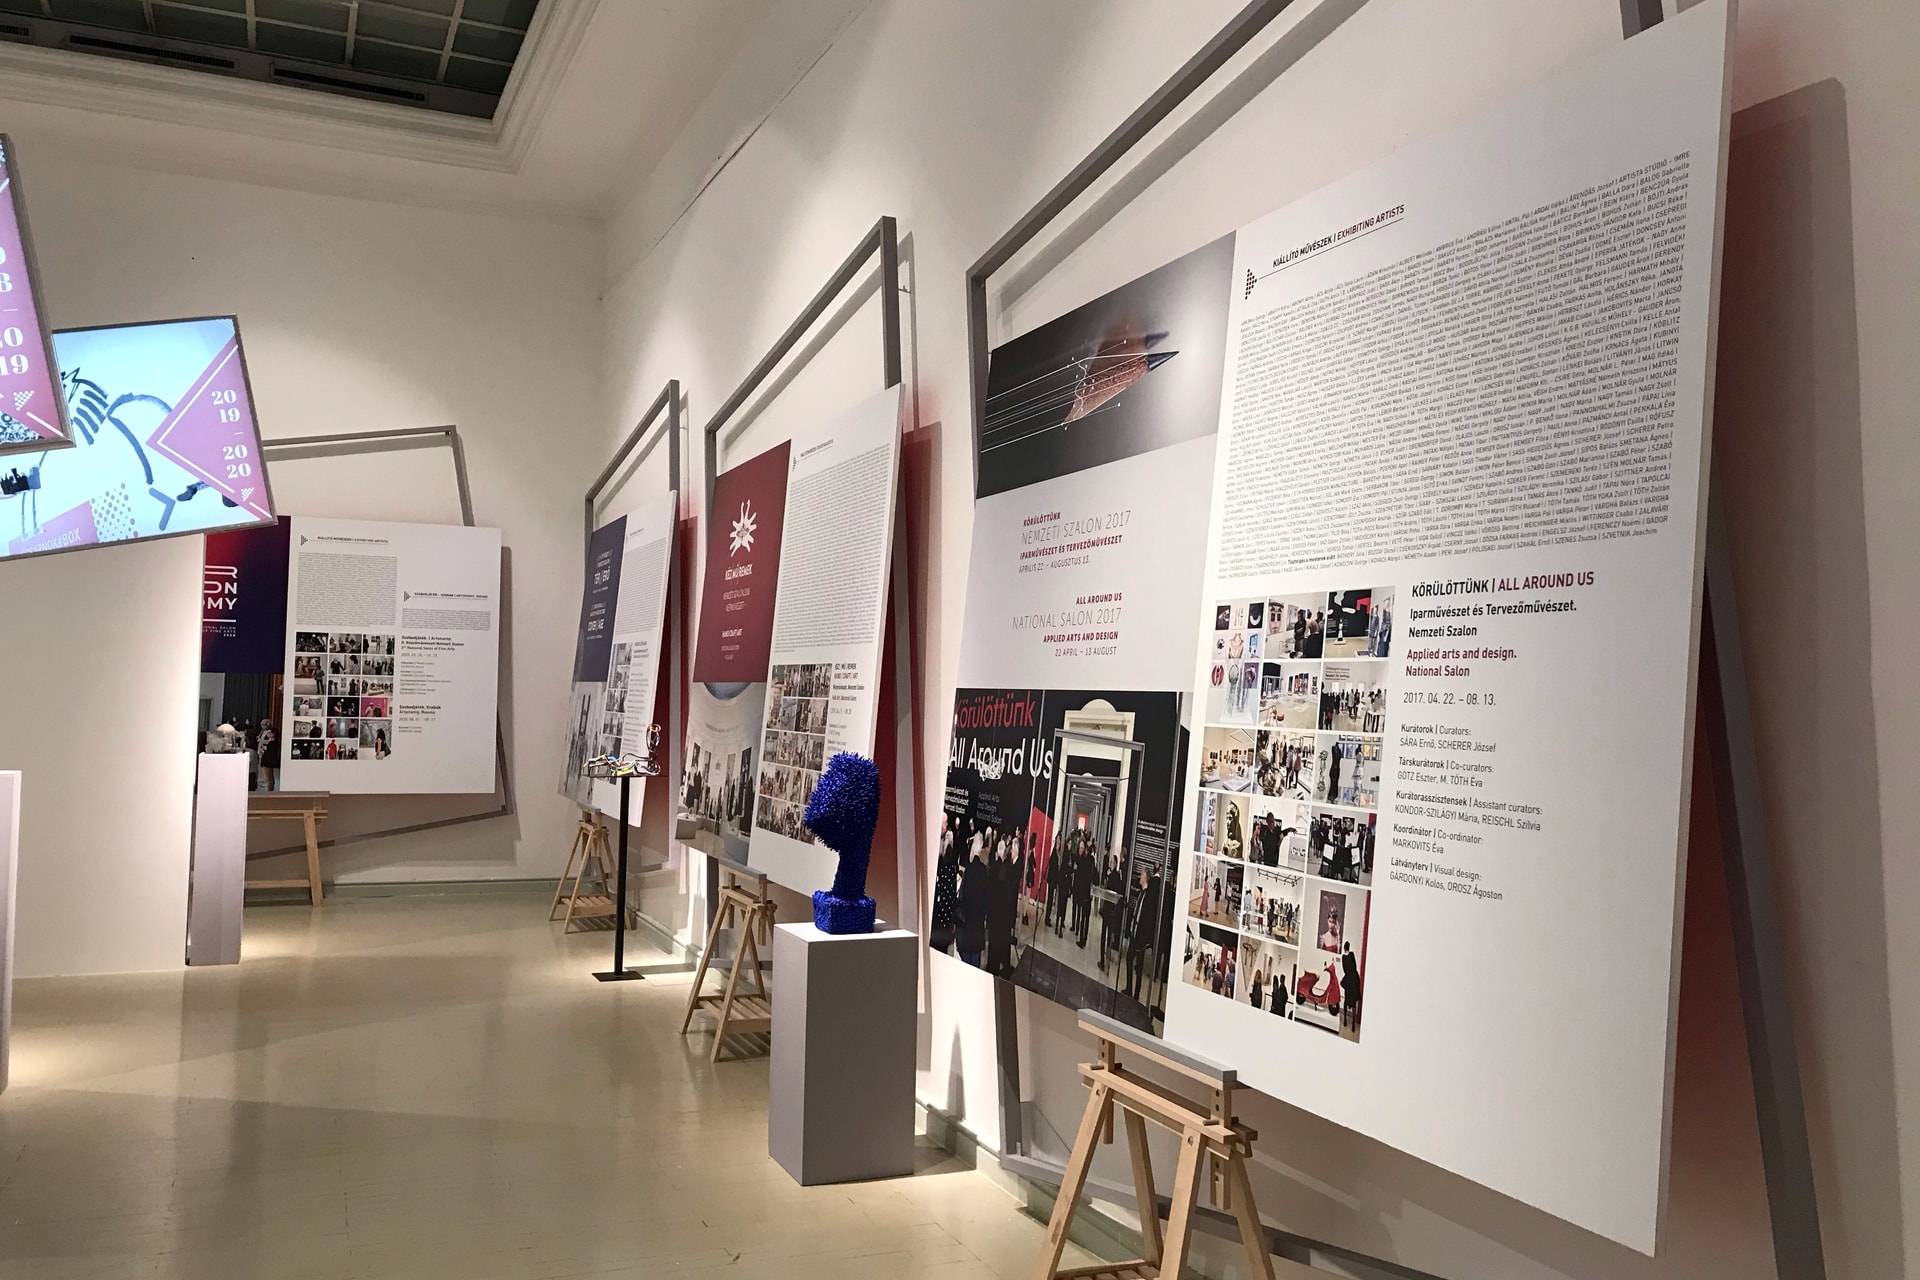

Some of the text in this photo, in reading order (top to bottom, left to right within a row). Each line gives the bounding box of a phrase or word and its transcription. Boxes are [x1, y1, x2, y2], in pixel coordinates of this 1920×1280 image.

[1673, 150, 1689, 162] IMRE
[1273, 204, 1405, 268] KIÁLLÍTÓ MŰVÉSZEK EXHIBITING ARTISTS
[0, 327, 23, 348] 0
[212, 390, 236, 405] 20
[219, 408, 240, 423] 19
[222, 444, 248, 460] 20
[226, 463, 251, 478] 20
[1024, 512, 1061, 526] KÖRÜLÖTTÜNK
[1022, 510, 1131, 544] NEMZETI SZALON 2017
[62, 528, 81, 546] BOX
[1050, 556, 1081, 568] AUGUSZTUS
[1412, 572, 1594, 597] KÖRÜLÖTTÜNK ALL AROUND US
[203, 597, 238, 610] MY
[1076, 592, 1122, 605] ALL AROUND US
[1410, 600, 1576, 621] Iparművészet és Tervezőművészet.
[1012, 608, 1122, 630] NATIONAL SALON 2017
[1043, 631, 1118, 643] APPLIED ARTS AND DESIGN
[1409, 625, 1477, 637] Nemzeti Szalon
[1062, 648, 1078, 656] APRIL
[1085, 647, 1092, 656] 13
[1093, 646, 1117, 656] AUGUST
[1407, 646, 1517, 661] Applied arts and design.
[1406, 665, 1469, 676] National Salon
[1403, 692, 1496, 706] 2017. 04. 22. 08. 13.
[1401, 724, 1471, 736] Kurátorok Curators:
[1400, 737, 1417, 747] SÁRA
[1438, 740, 1471, 750] SCHERER
[1473, 742, 1496, 752] József
[967, 738, 1026, 776] Around
[1030, 738, 1054, 780] Us
[1399, 757, 1494, 773] Társkurátorok Co-curators:
[1416, 772, 1438, 784] Eszter,
[1450, 774, 1468, 785] TÓTH
[1471, 777, 1482, 787] Éva
[1473, 798, 1506, 810] Assistant
[1508, 802, 1543, 815] curators:
[1482, 816, 1514, 828] REISCHL
[1517, 819, 1541, 830] Szilvia
[1394, 824, 1483, 844] Koordinátor Co-ordinator:
[1392, 838, 1444, 853] MARKOVITS Éva
[1391, 857, 1482, 881] Látványterv Visual design:
[1390, 871, 1502, 900] GÁRDONYI Kolos, OROSZ Ágoston
